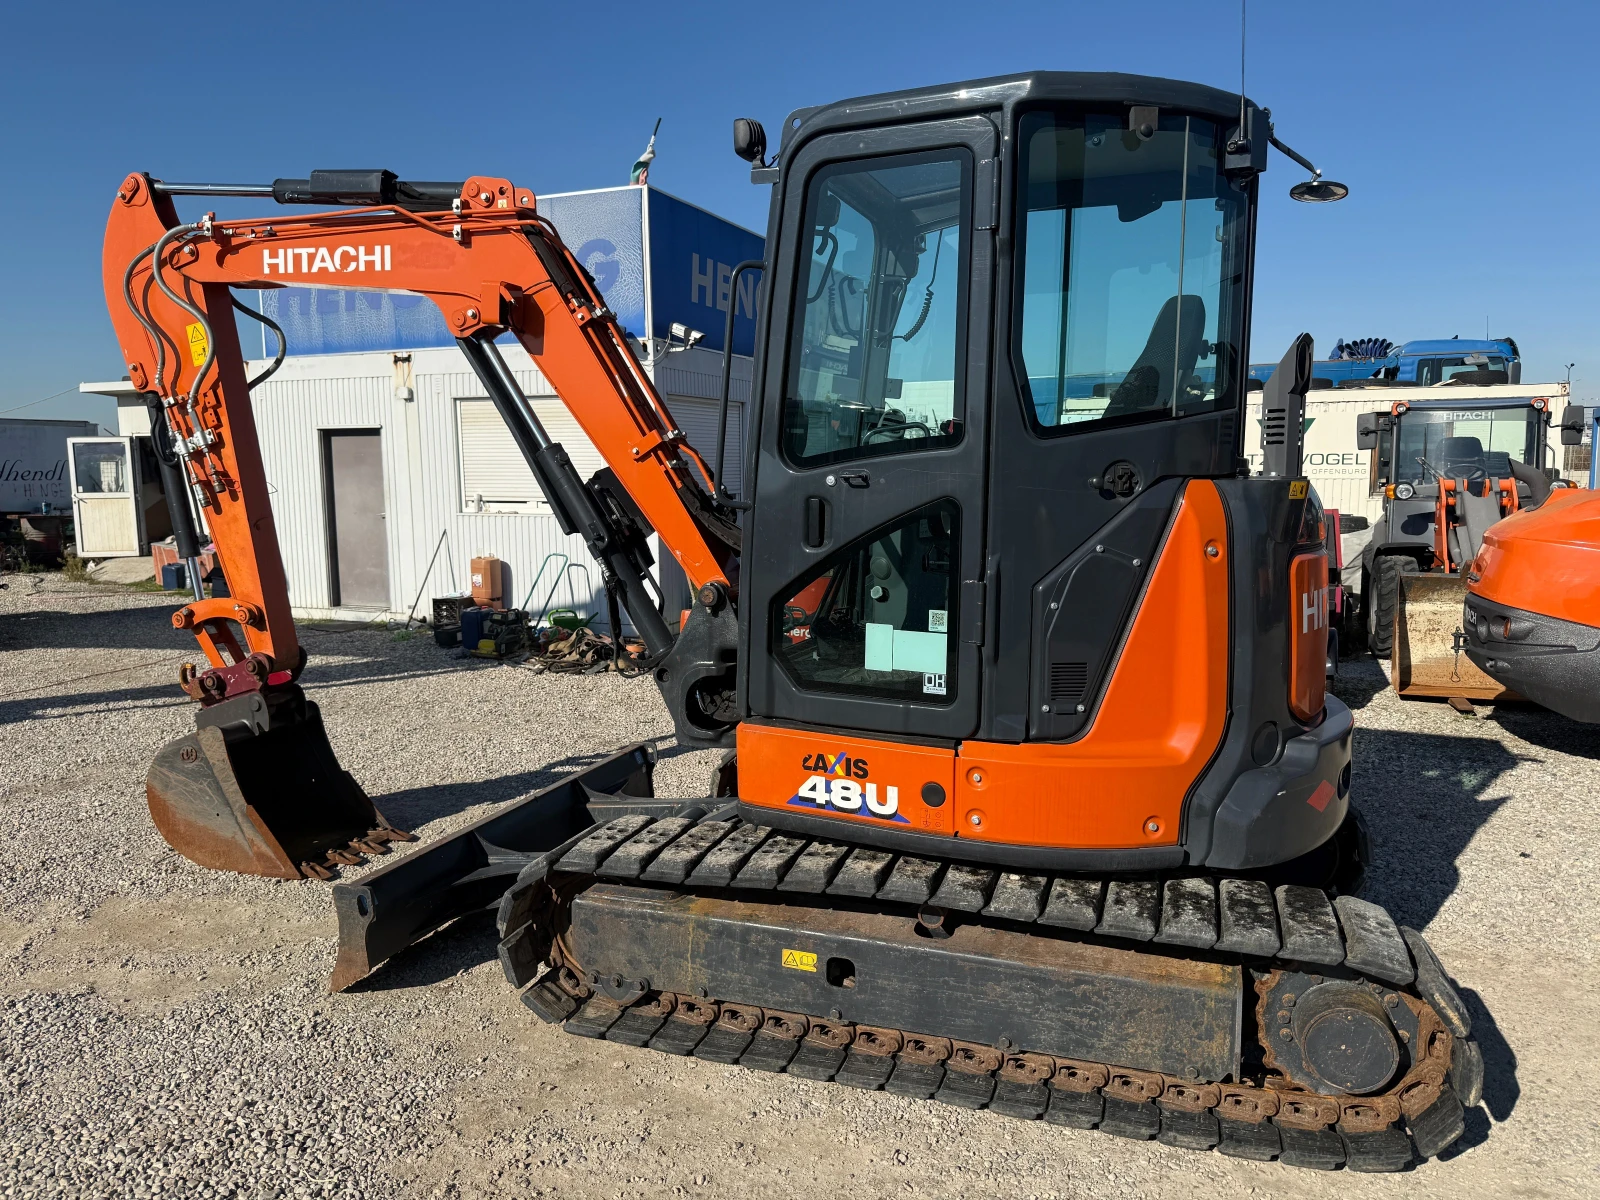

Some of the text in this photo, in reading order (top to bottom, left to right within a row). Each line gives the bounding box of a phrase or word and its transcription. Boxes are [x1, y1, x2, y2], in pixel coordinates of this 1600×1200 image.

[263, 245, 391, 274] HITACHI
[1443, 410, 1495, 421] HITACHI
[798, 775, 898, 820] 48U
